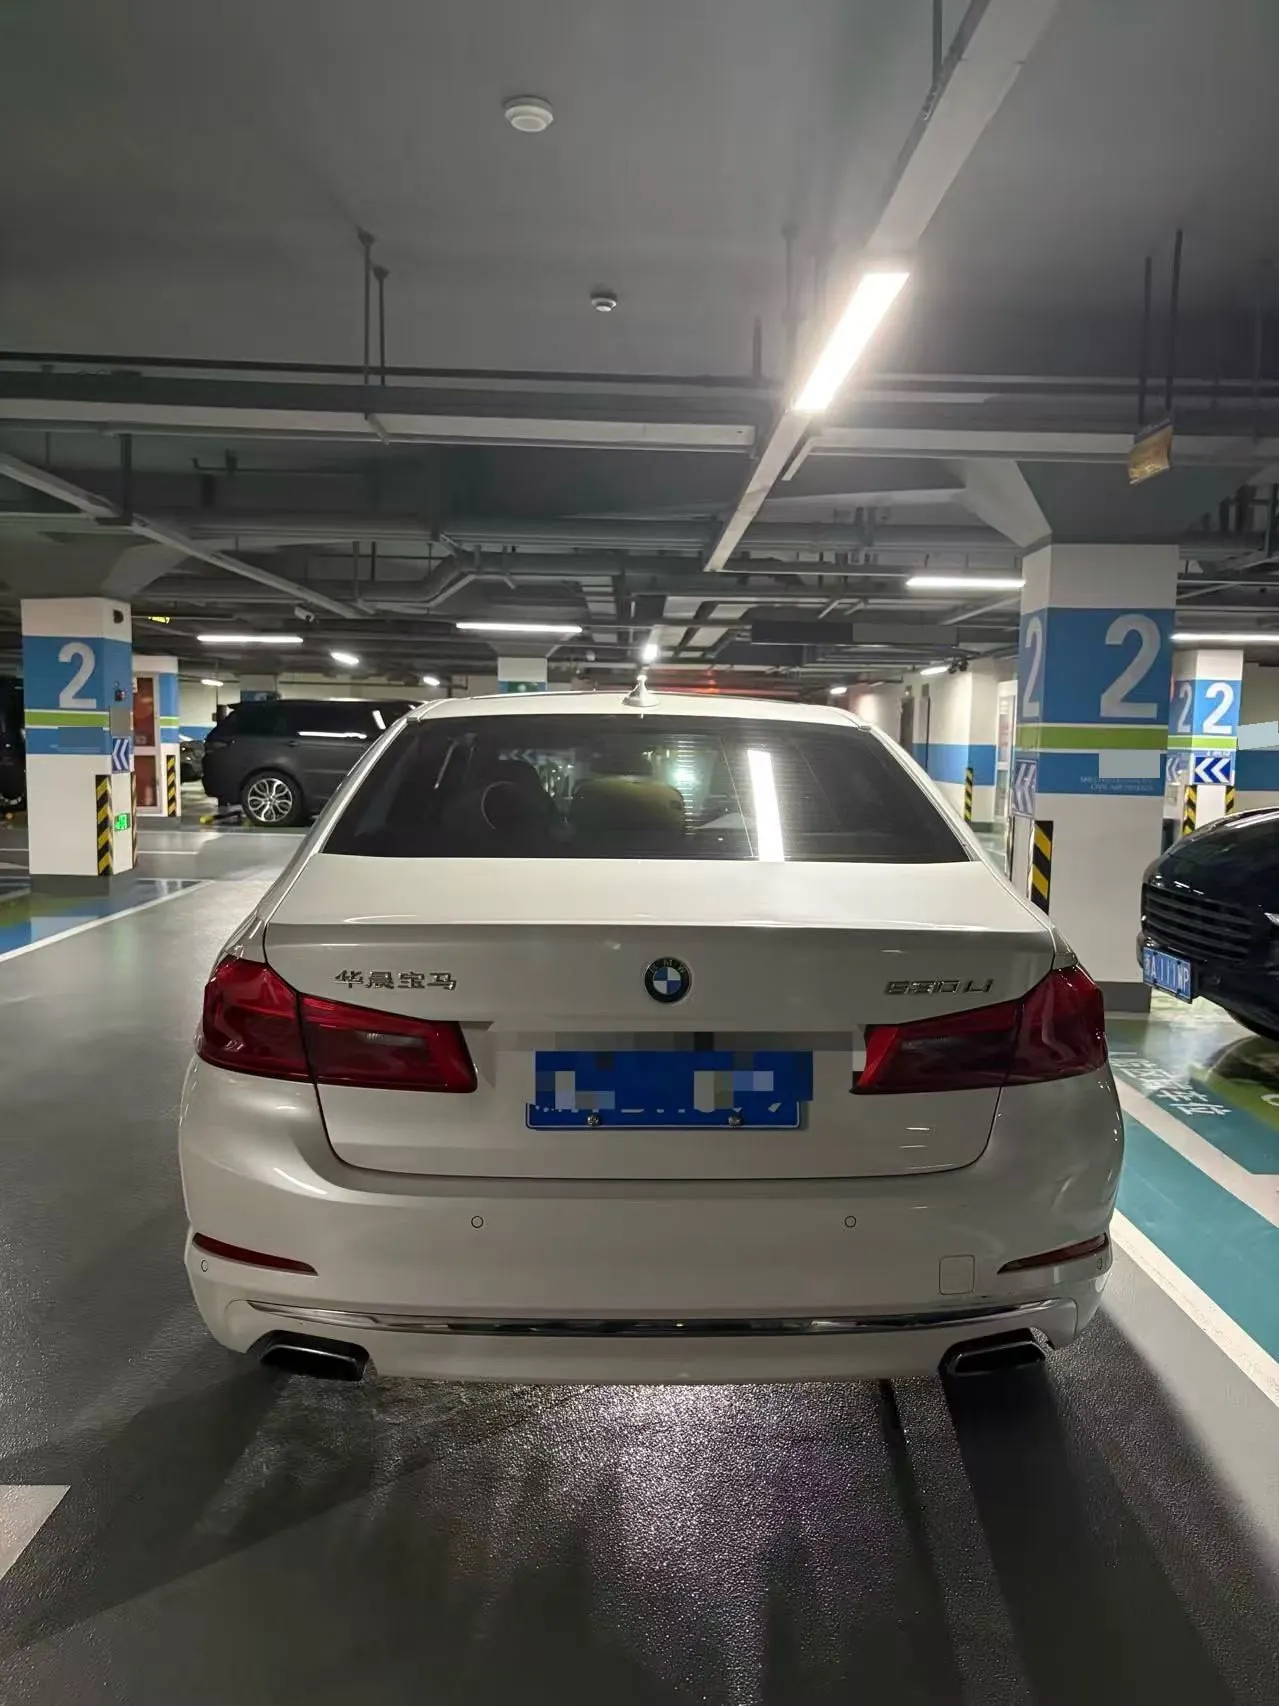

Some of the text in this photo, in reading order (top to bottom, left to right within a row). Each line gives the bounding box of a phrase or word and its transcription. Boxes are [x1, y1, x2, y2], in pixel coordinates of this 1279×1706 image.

[58, 642, 97, 709] 2
[1022, 616, 1043, 718] 2
[1099, 613, 1161, 718] 2
[1177, 682, 1193, 734] 2
[1202, 682, 1234, 734] 2
[334, 969, 457, 990] 华晨宝马
